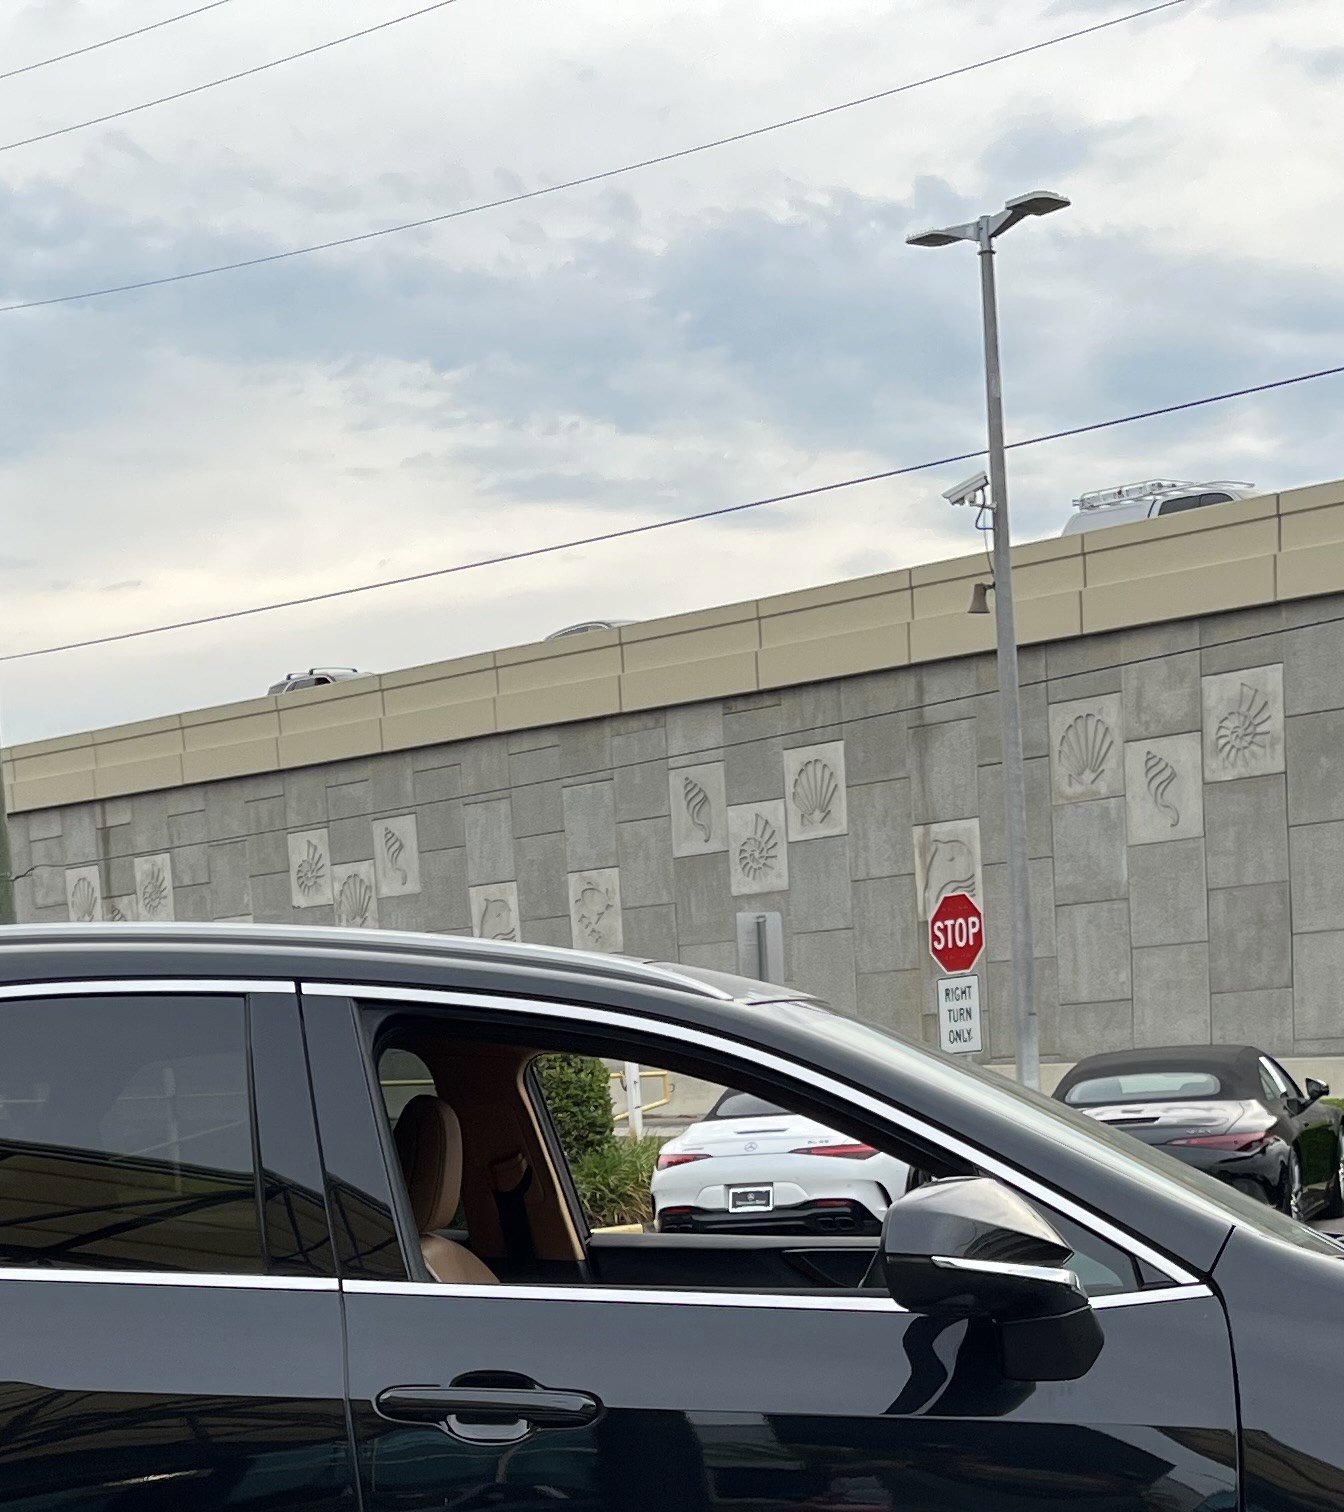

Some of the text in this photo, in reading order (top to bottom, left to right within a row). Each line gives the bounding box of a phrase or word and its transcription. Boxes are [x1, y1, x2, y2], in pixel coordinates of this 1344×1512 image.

[933, 916, 980, 950] STOP
[944, 985, 972, 1002] RIGHT
[947, 1007, 973, 1023] TURN
[948, 1028, 973, 1045] ONLY
